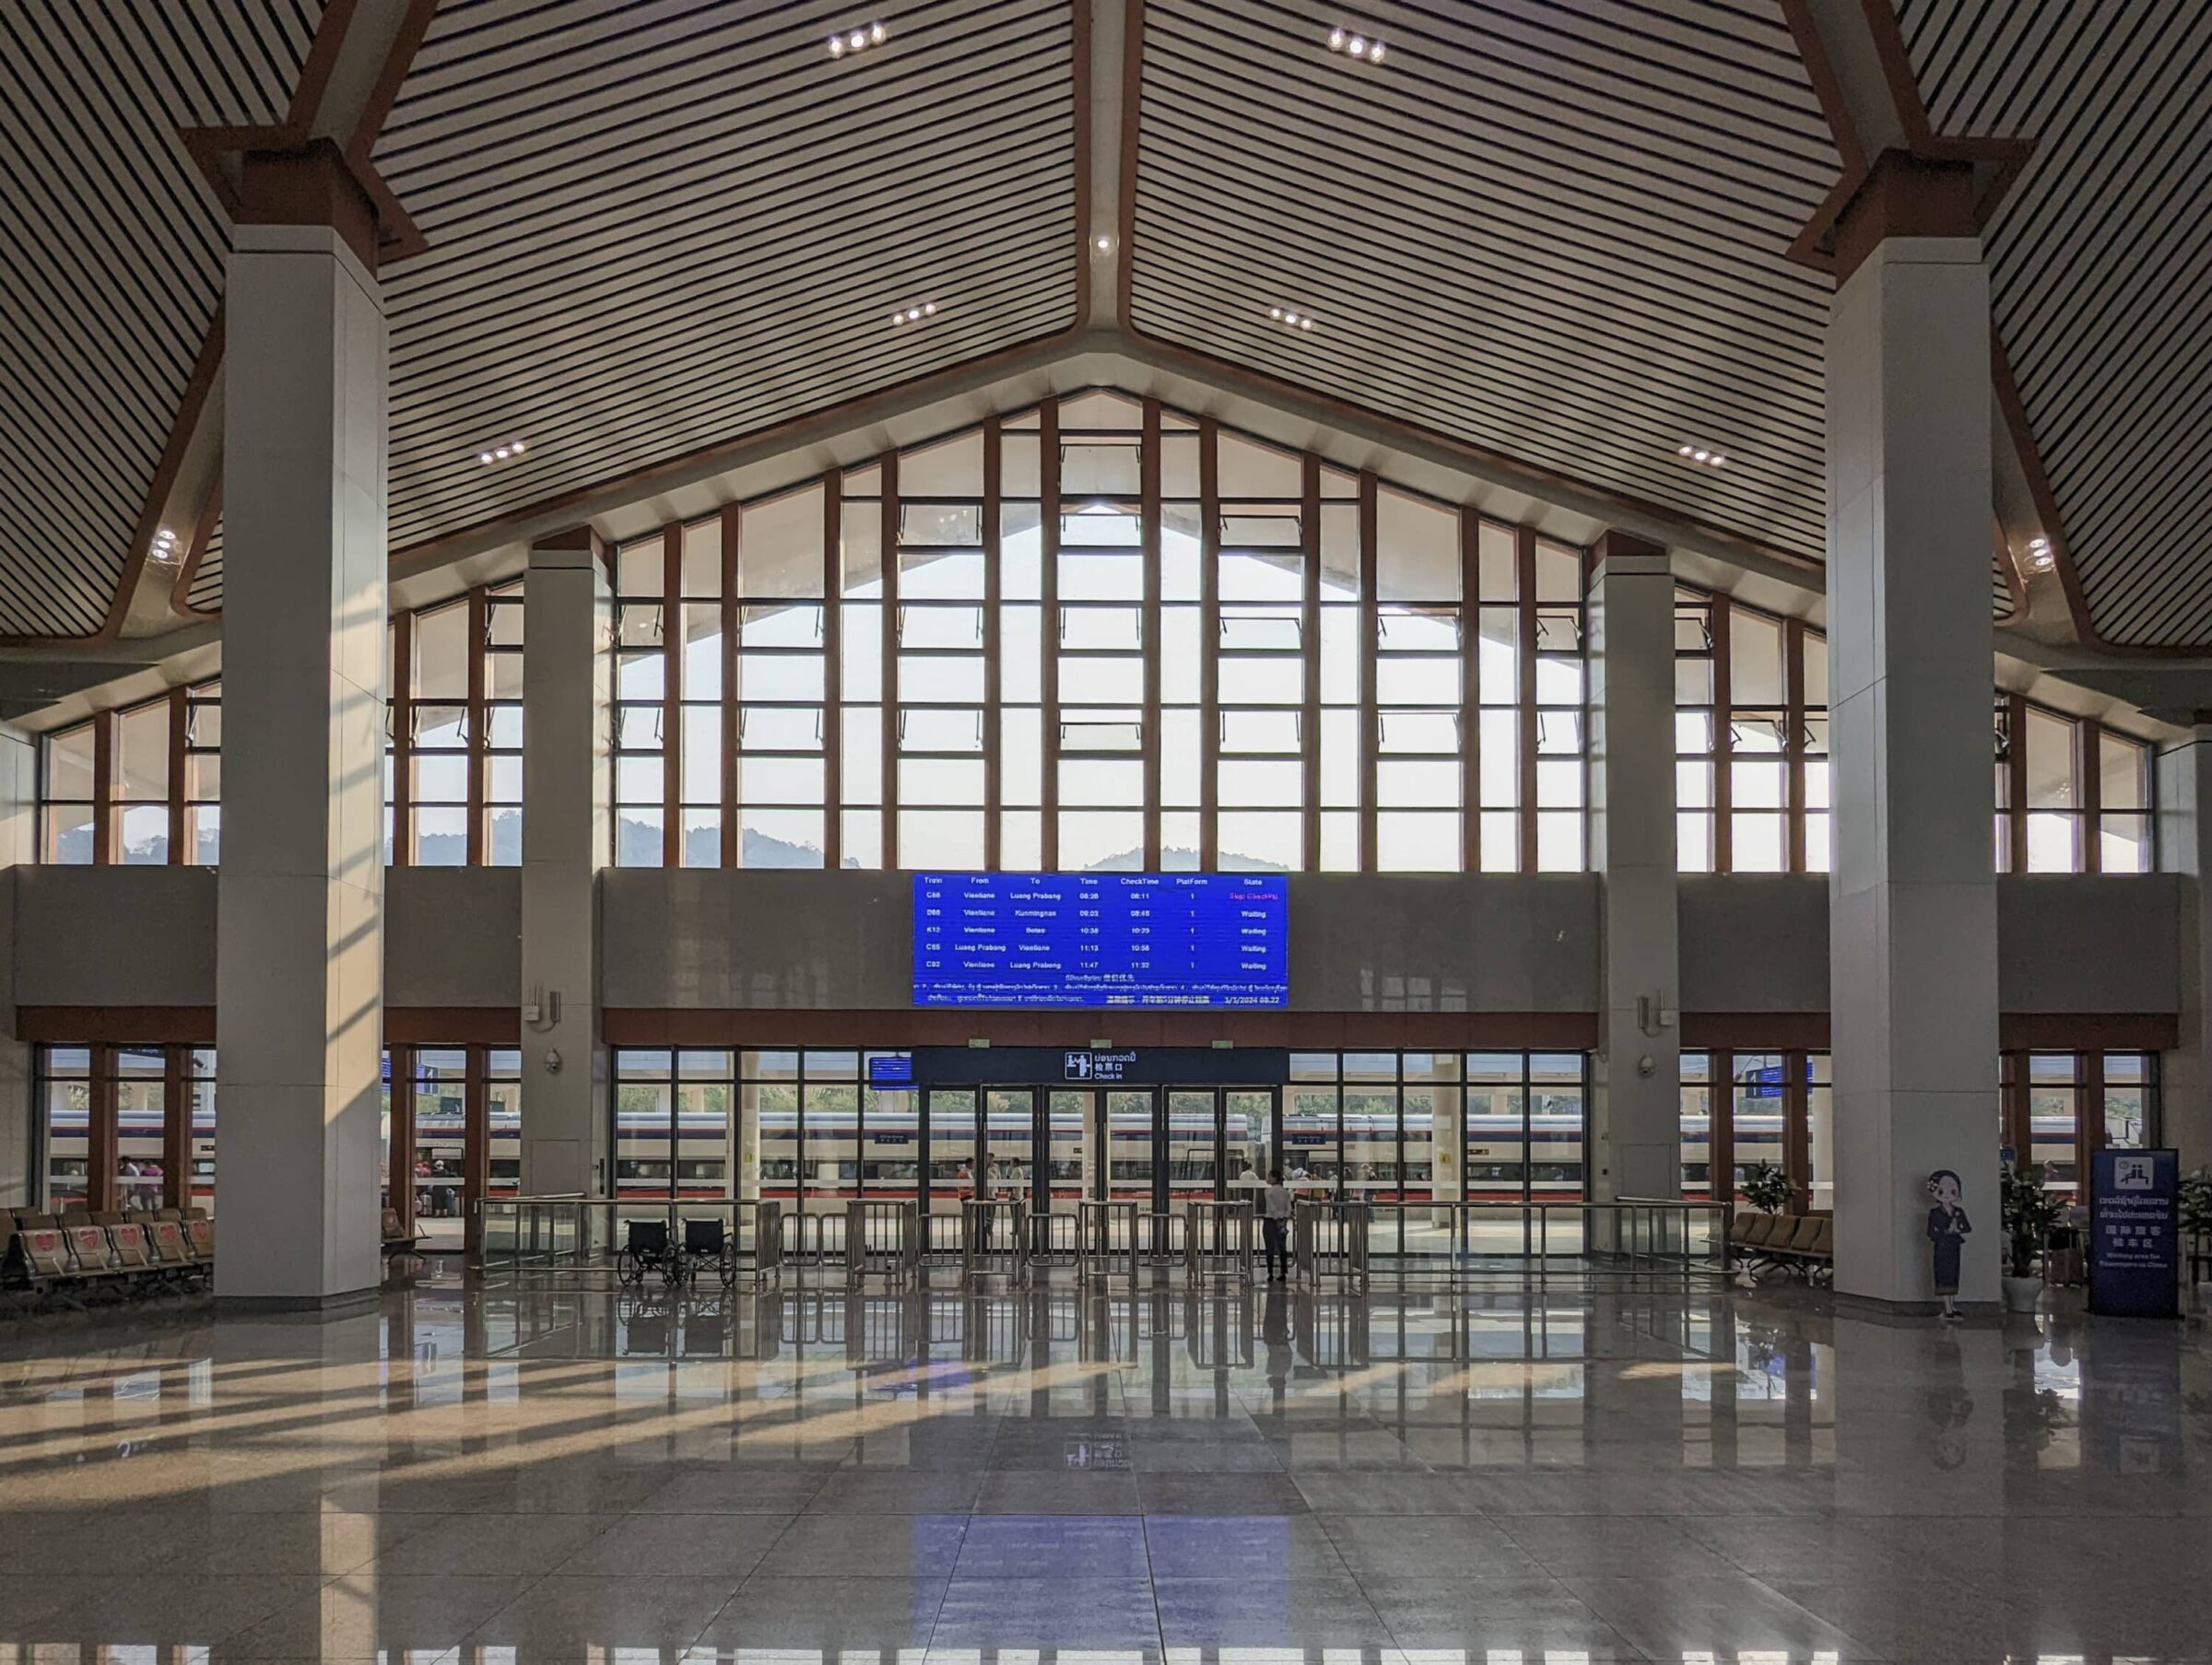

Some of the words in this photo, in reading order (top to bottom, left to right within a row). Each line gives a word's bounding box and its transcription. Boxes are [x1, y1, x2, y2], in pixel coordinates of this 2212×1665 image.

[971, 876, 989, 885] From
[1030, 877, 1041, 885] To
[1120, 877, 1159, 885] CheckTime
[1009, 892, 1031, 900] Luang
[1032, 892, 1062, 901] Prabang
[963, 909, 995, 917] Vientiane
[1015, 909, 1057, 919] Kunmingnan
[1190, 909, 1194, 918] 1
[1241, 910, 1266, 920] Waiting
[1241, 928, 1267, 936] Waiting
[954, 944, 976, 953] Luang
[977, 944, 1006, 953] Prabang
[1018, 944, 1051, 952] Vientiane
[1241, 944, 1267, 954] Waiting
[1009, 961, 1031, 970] Luang
[1032, 961, 1062, 970] Prabang
[1241, 962, 1267, 970] Waiting
